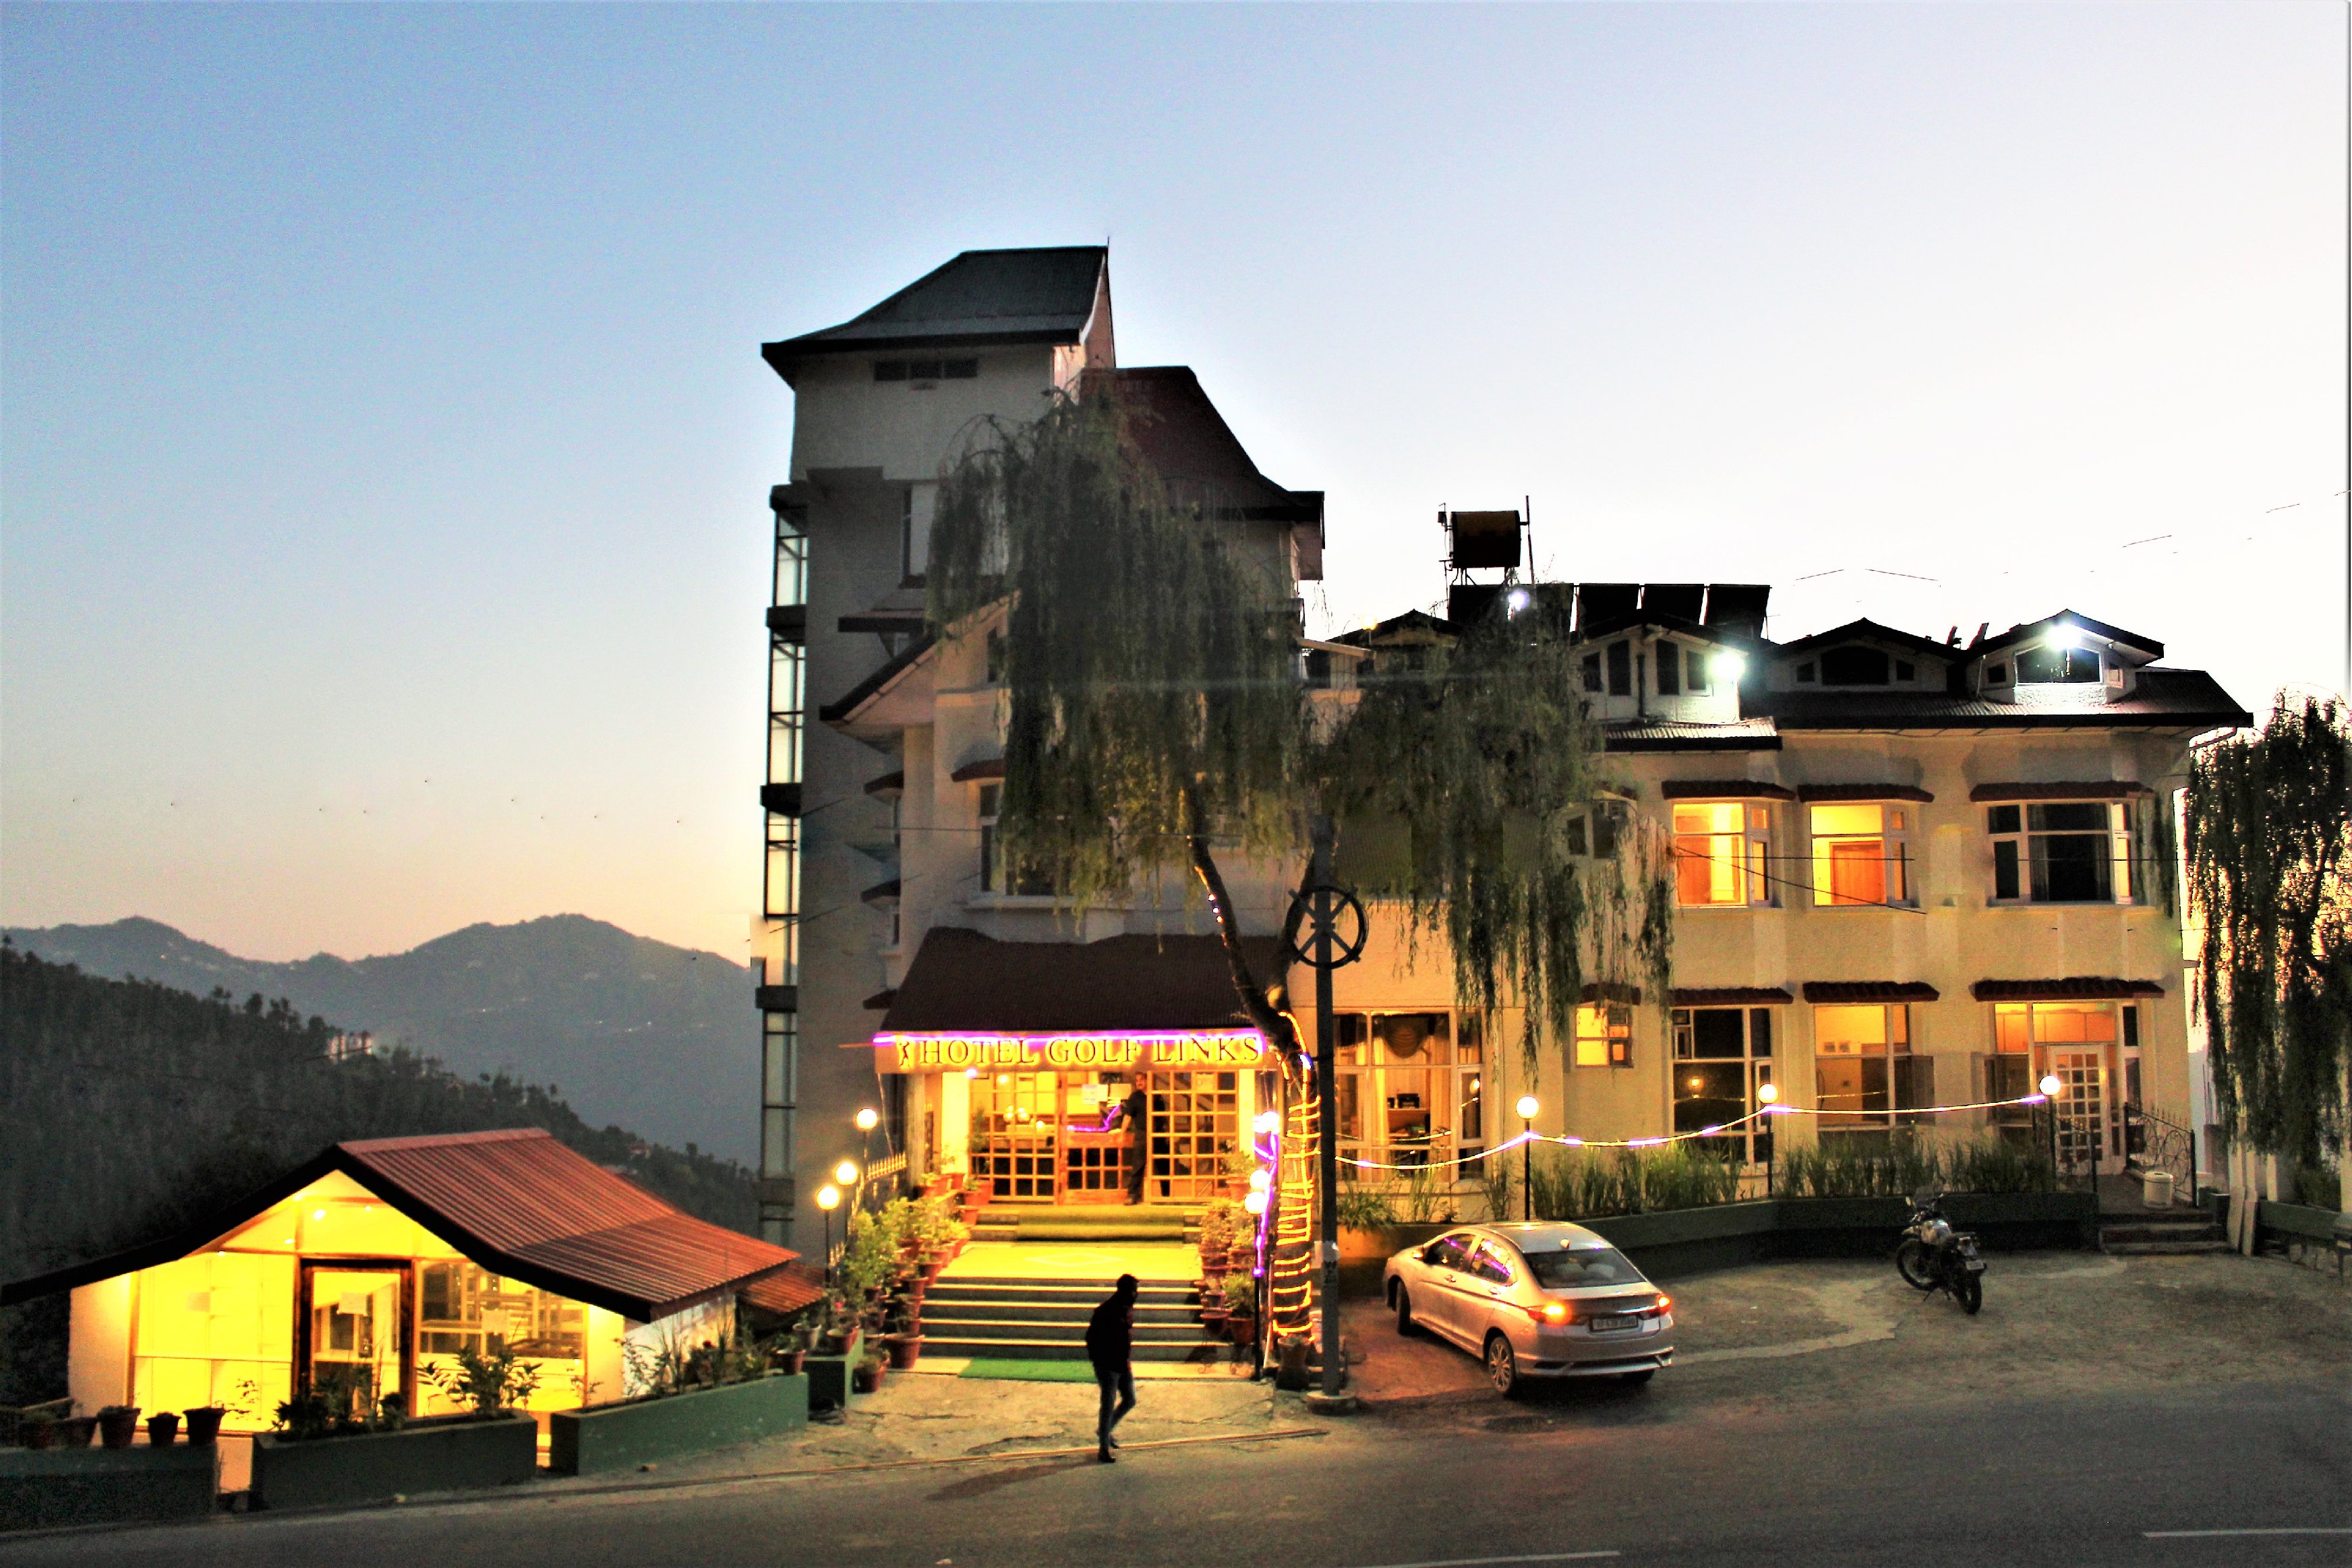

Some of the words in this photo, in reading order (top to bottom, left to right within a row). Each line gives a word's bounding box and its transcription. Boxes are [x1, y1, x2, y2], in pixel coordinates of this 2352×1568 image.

[919, 1039, 1038, 1064] HOTEL
[1049, 1038, 1138, 1063] GOLF
[1153, 1036, 1259, 1062] LINKS
